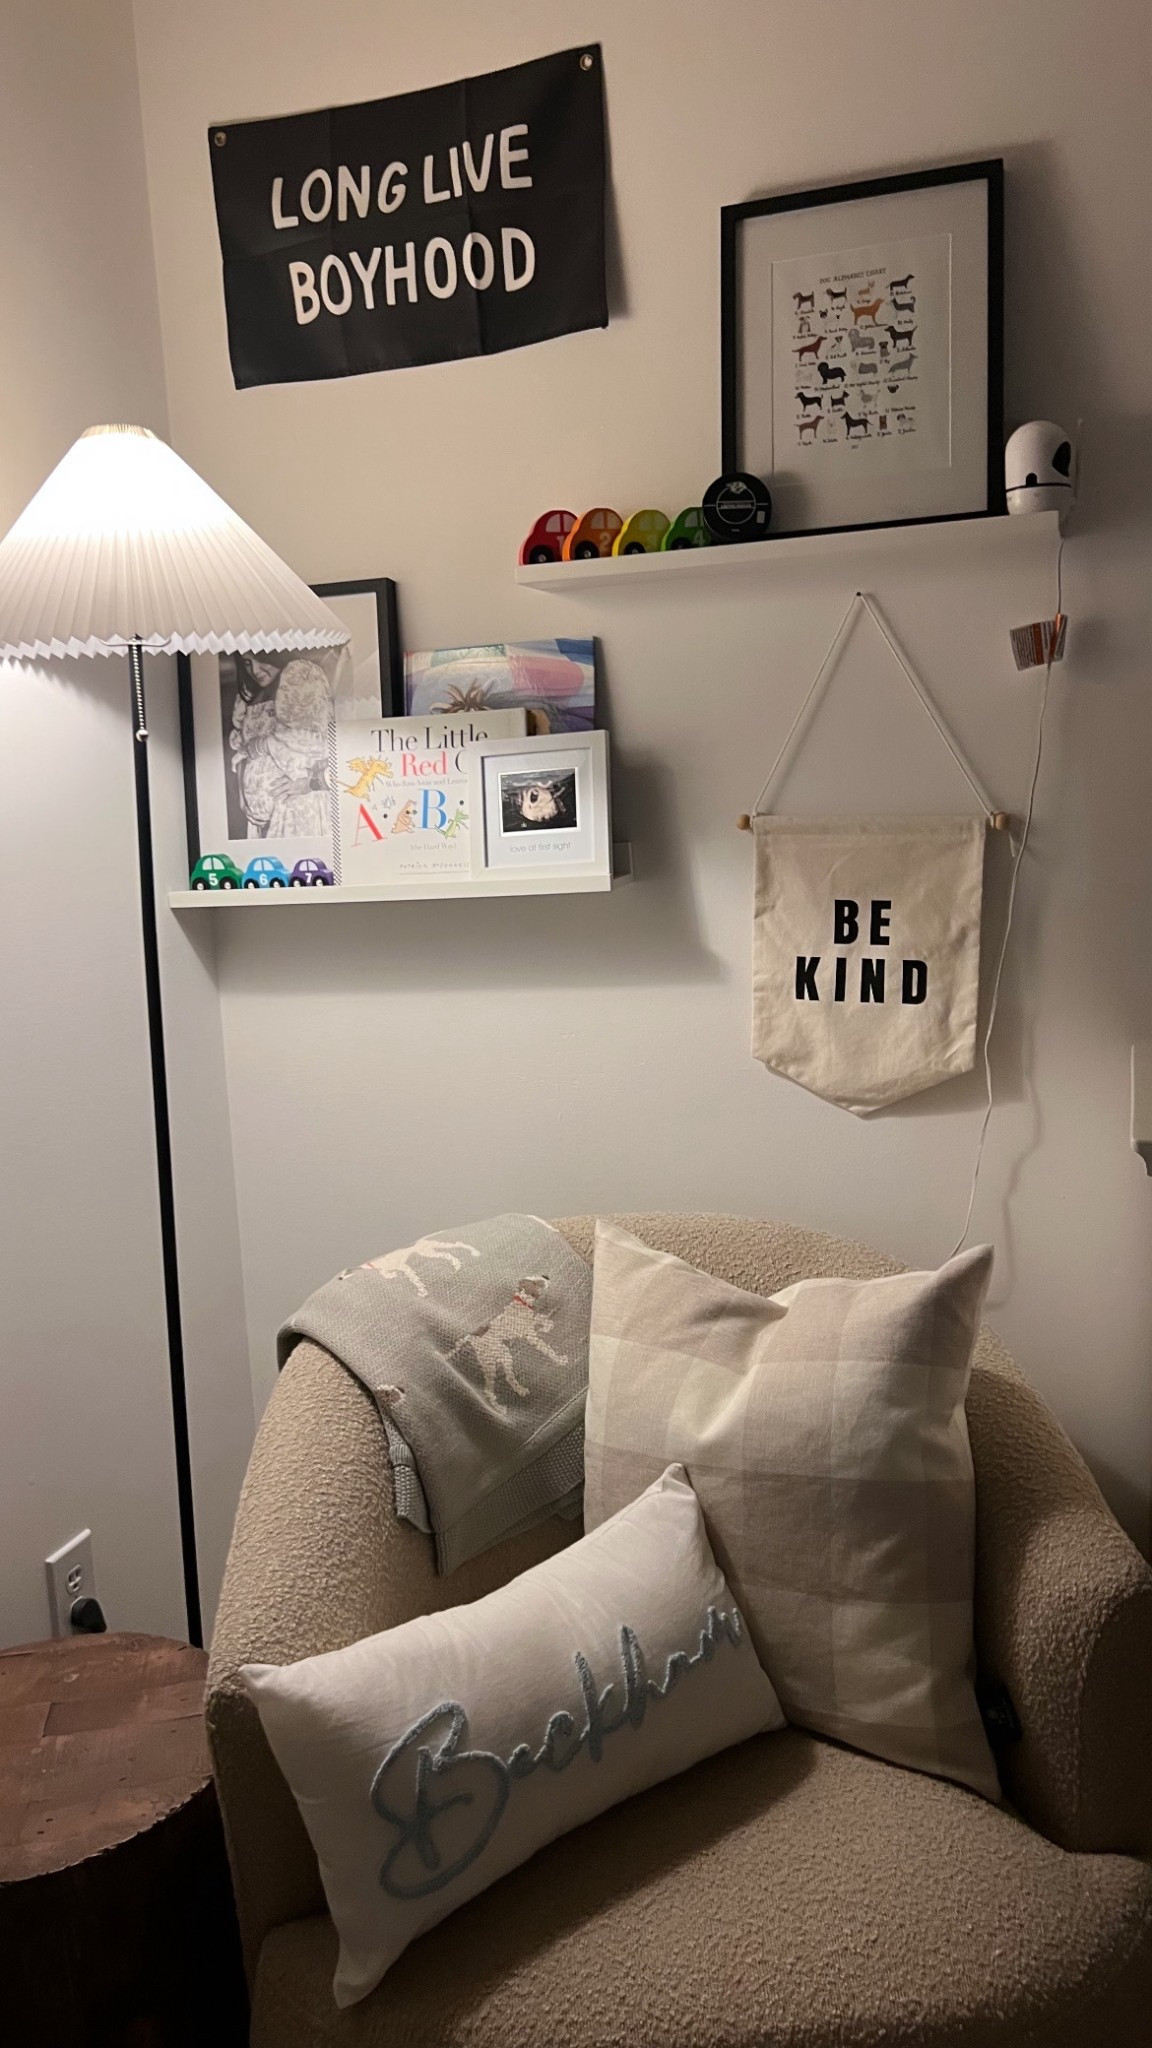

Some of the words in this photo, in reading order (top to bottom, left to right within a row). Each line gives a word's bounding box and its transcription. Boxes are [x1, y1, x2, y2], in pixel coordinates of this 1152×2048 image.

[271, 161, 409, 230] LONG
[423, 123, 533, 205] LIVE
[288, 227, 536, 326] BOYHOOD
[599, 532, 612, 549] 2
[693, 530, 706, 546] 4
[370, 728, 418, 752] The
[423, 723, 488, 750] Little
[400, 751, 448, 777] Red
[350, 802, 388, 848] A
[419, 788, 448, 830] B
[423, 842, 440, 850] Hard
[509, 845, 527, 853] love
[528, 844, 537, 852] at
[538, 842, 551, 851] first
[552, 841, 571, 852] sight
[208, 873, 219, 886] 5
[259, 873, 268, 886] 6
[304, 872, 313, 884] 7
[833, 898, 892, 946] BE
[795, 955, 928, 1006] KIND
